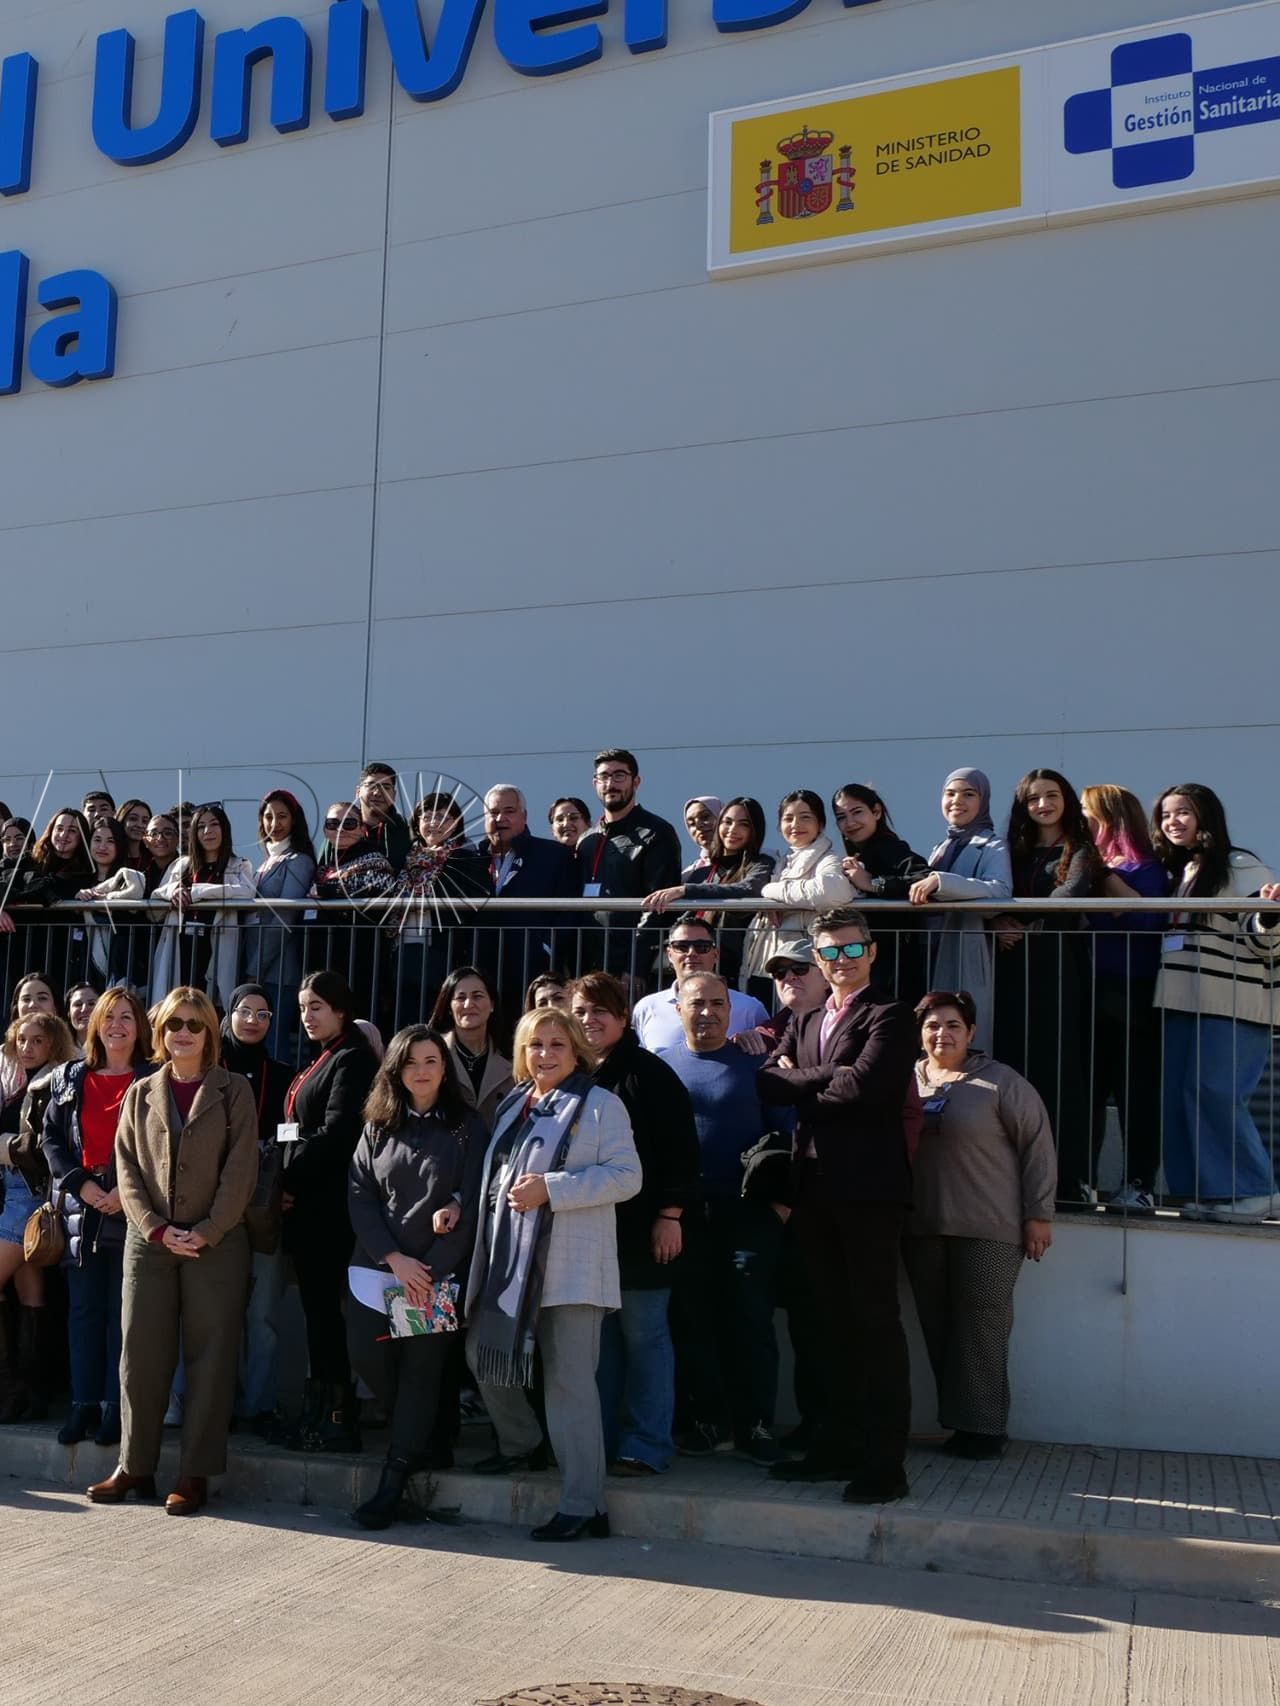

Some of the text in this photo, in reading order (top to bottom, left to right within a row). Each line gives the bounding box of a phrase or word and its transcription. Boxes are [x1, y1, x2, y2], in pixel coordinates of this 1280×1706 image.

[1144, 74, 1267, 104] Instituto Nacional de
[1124, 89, 1280, 133] Gestión Sanitaria
[876, 127, 981, 158] MINISTERIO
[876, 143, 991, 176] DE SANIDAD
